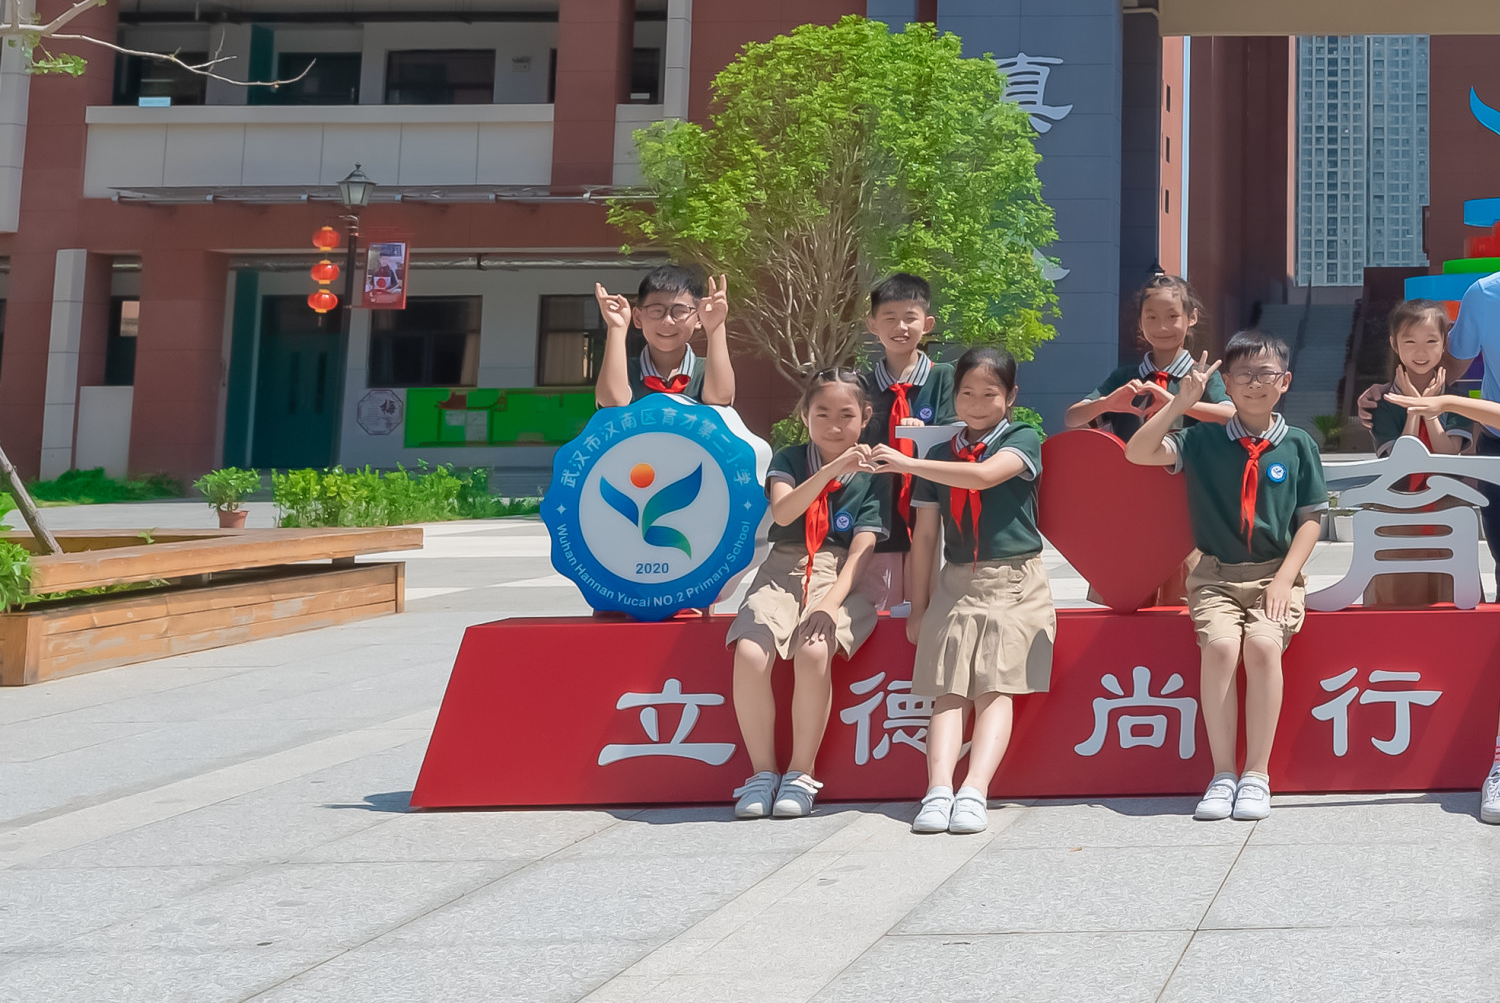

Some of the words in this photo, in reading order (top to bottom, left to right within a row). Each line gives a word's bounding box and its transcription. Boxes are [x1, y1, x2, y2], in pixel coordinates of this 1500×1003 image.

[560, 407, 751, 489] 武汉市汉南区育才第二小学
[556, 523, 577, 566] Wuhan
[574, 563, 614, 599] Hannan
[617, 591, 650, 607] Yucai
[685, 562, 730, 598] Primary
[726, 520, 751, 563] School
[635, 562, 669, 574] 2020
